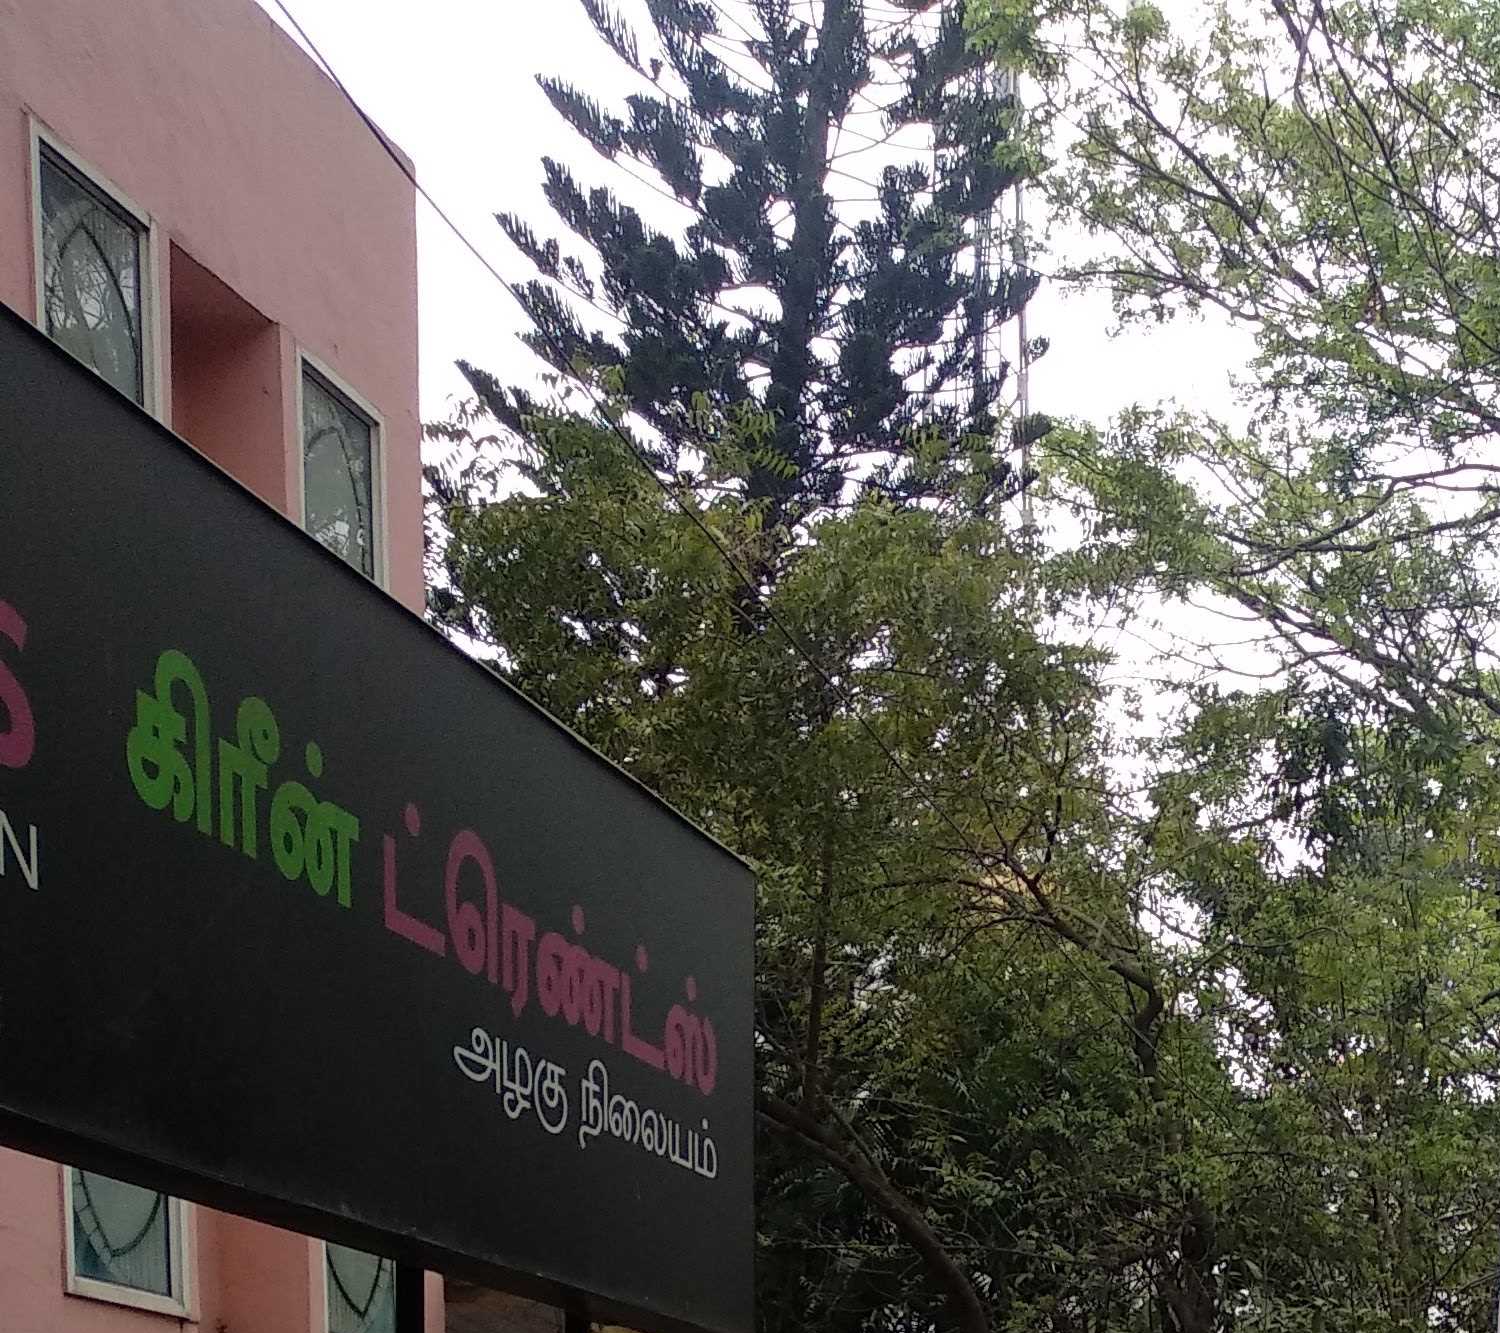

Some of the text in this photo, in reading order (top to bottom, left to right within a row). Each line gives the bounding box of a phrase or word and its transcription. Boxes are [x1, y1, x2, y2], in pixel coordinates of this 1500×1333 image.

[127, 649, 360, 909] கிரீன்
[453, 1027, 717, 1179] அழகு நிலையம்
